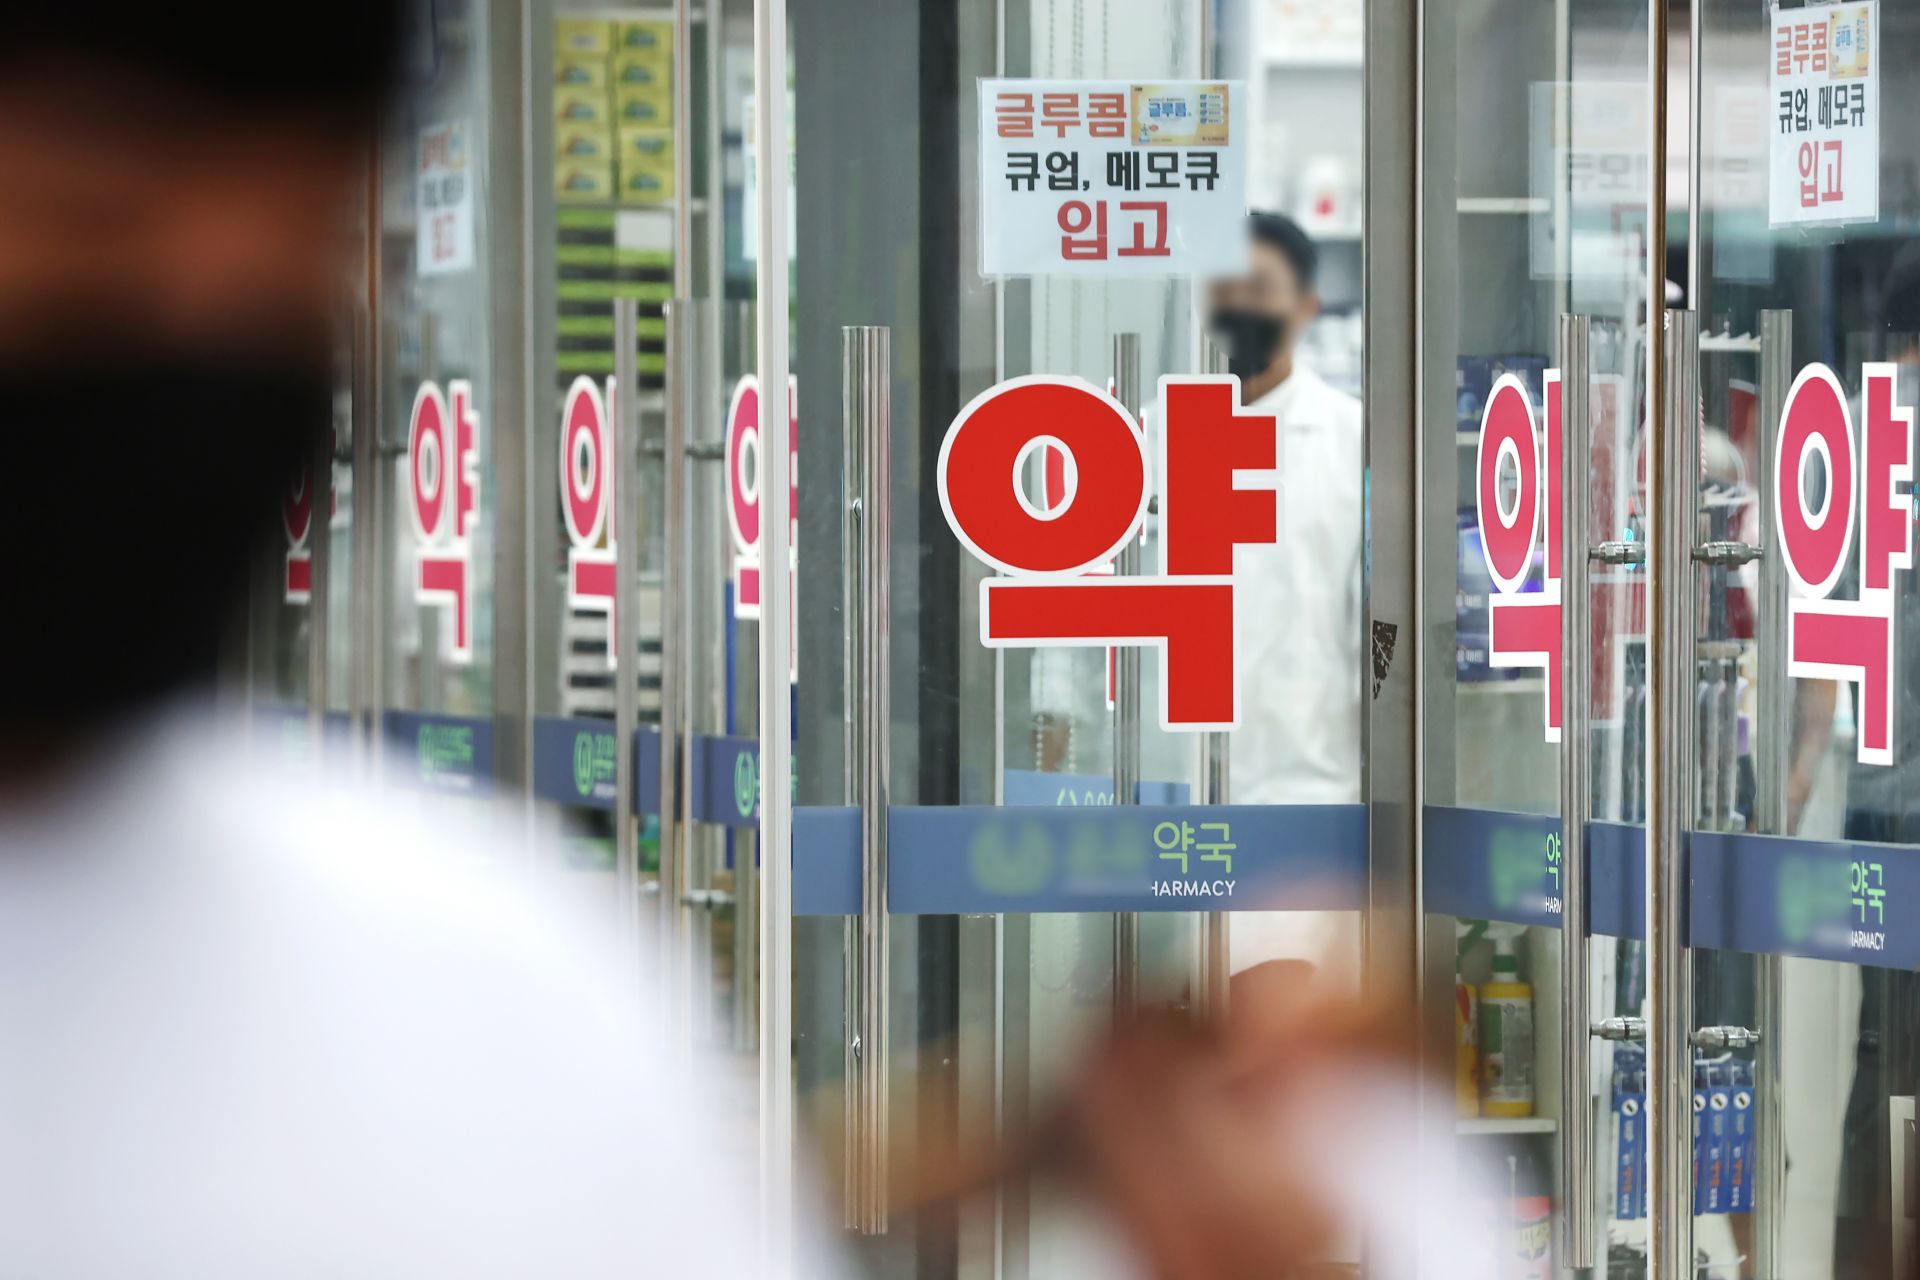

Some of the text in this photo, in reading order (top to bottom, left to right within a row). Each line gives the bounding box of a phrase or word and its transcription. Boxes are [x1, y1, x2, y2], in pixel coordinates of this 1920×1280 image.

[1776, 22, 1828, 75] 글루콤
[995, 92, 1127, 138] 글루콤
[1779, 83, 1865, 133] 큐업, 메모큐
[1005, 151, 1220, 192] 큐업, 메모큐
[1798, 140, 1844, 207] 입고
[1057, 200, 1171, 260] 입고
[410, 382, 478, 660] 약
[940, 377, 1281, 730] 약
[1777, 364, 1914, 763] 약
[1153, 820, 1237, 874] 약국
[1851, 861, 1886, 925] 약국
